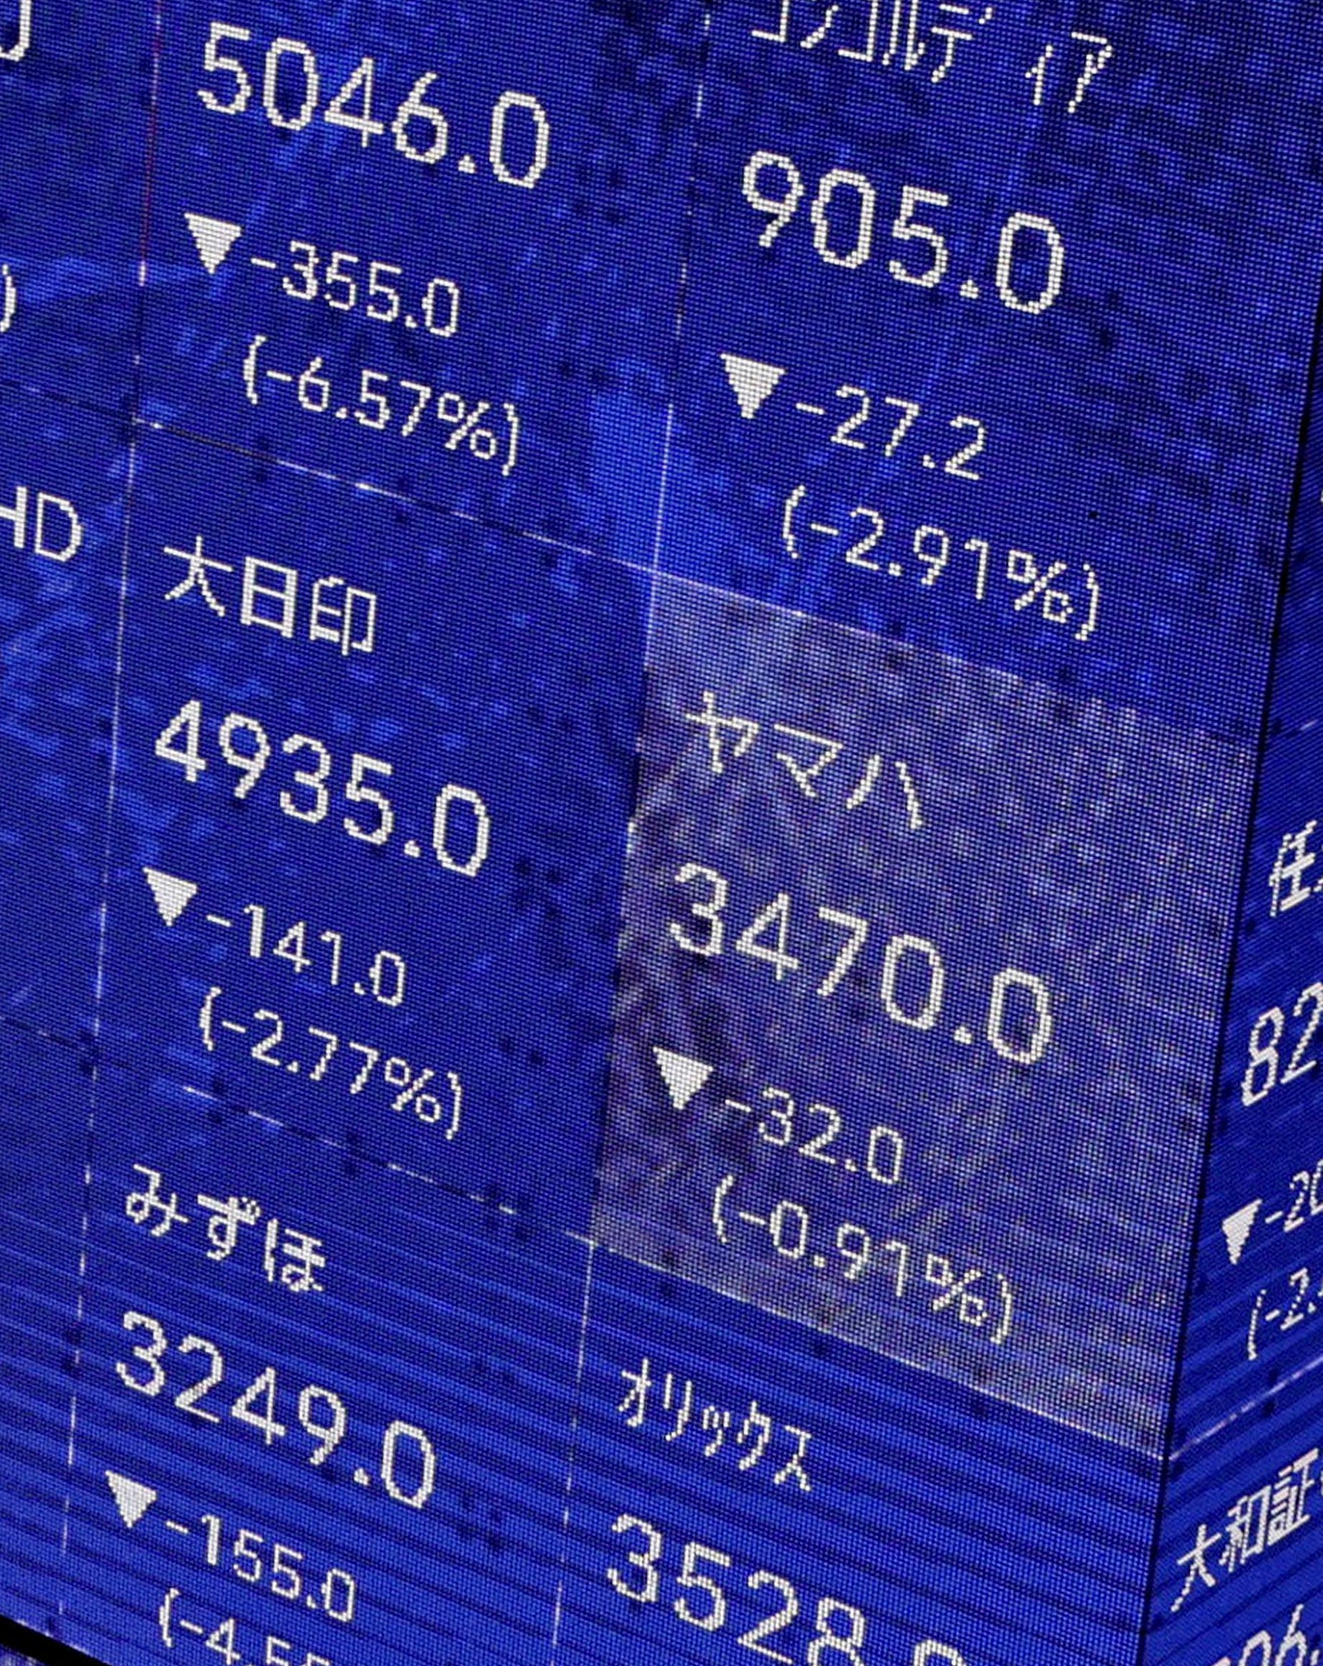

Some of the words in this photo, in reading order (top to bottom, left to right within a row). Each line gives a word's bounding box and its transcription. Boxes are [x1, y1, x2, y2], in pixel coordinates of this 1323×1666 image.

[741, 149, 1066, 316] 905.0
[163, 534, 378, 657] 大日印
[782, 484, 1101, 642] (-2.91%)
[154, 699, 491, 878] 4935.0
[683, 690, 923, 831] ヤマハ
[665, 862, 1053, 1065] 3470.0
[725, 1086, 904, 1185] -32.0
[125, 1163, 326, 1293] みずほ
[114, 1310, 437, 1509] 3249.0
